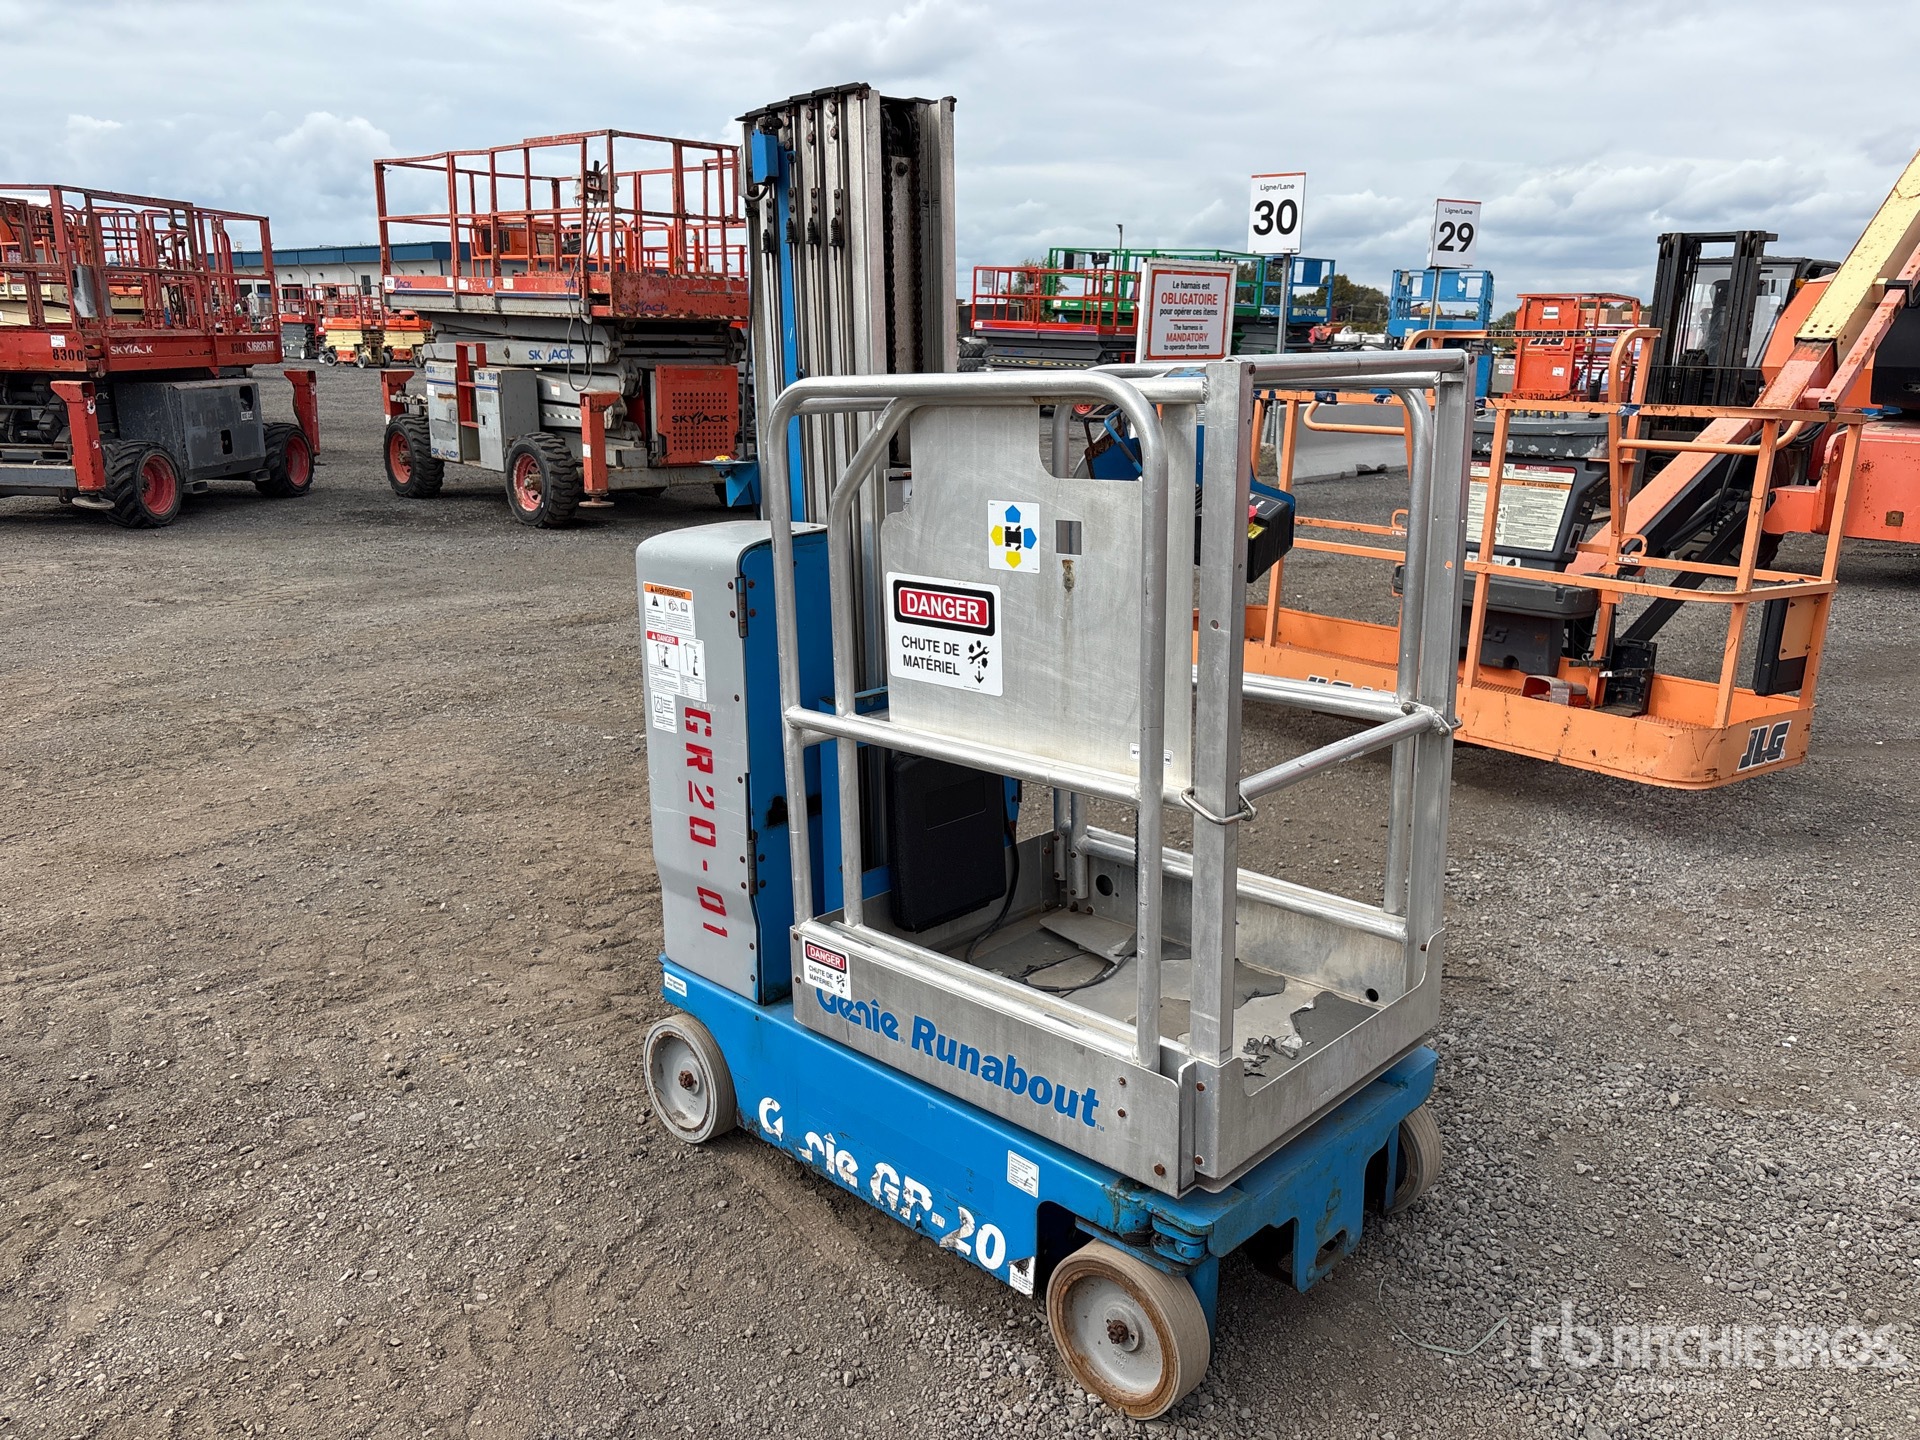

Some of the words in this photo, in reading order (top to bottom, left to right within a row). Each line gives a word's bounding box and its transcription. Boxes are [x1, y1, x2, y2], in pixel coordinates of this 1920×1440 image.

[1260, 184, 1295, 192] Ligne/Lane
[1253, 199, 1298, 235] 30
[1445, 207, 1473, 215] Ligne/Lane
[1437, 221, 1474, 252] 29
[1172, 281, 1180, 289] Le
[1181, 281, 1201, 290] harnais
[1202, 282, 1210, 290] est
[1161, 292, 1218, 305] OBLIGATOIRE
[1160, 308, 1173, 317] pour
[1174, 307, 1192, 317] opérer
[1203, 307, 1218, 316] items
[1166, 333, 1208, 342] MANDATORY
[52, 348, 84, 361] 8300
[671, 410, 729, 425] SKYJACK
[655, 586, 686, 598] AVERTISSEMENT
[907, 592, 980, 622] DANGER
[656, 633, 676, 644] DANGER
[901, 635, 940, 654] CHUTE
[944, 641, 960, 656] DE
[903, 654, 960, 676] MATÉRIEL
[1737, 720, 1792, 771] JLG
[685, 707, 728, 938] GR20-01
[810, 947, 841, 967] DANGER
[809, 965, 825, 977] CHUTE
[826, 971, 833, 980] DE
[809, 973, 834, 988] MATÉRIEL
[911, 1015, 1100, 1128] Runabout
[870, 1162, 1006, 1270] GR-20
